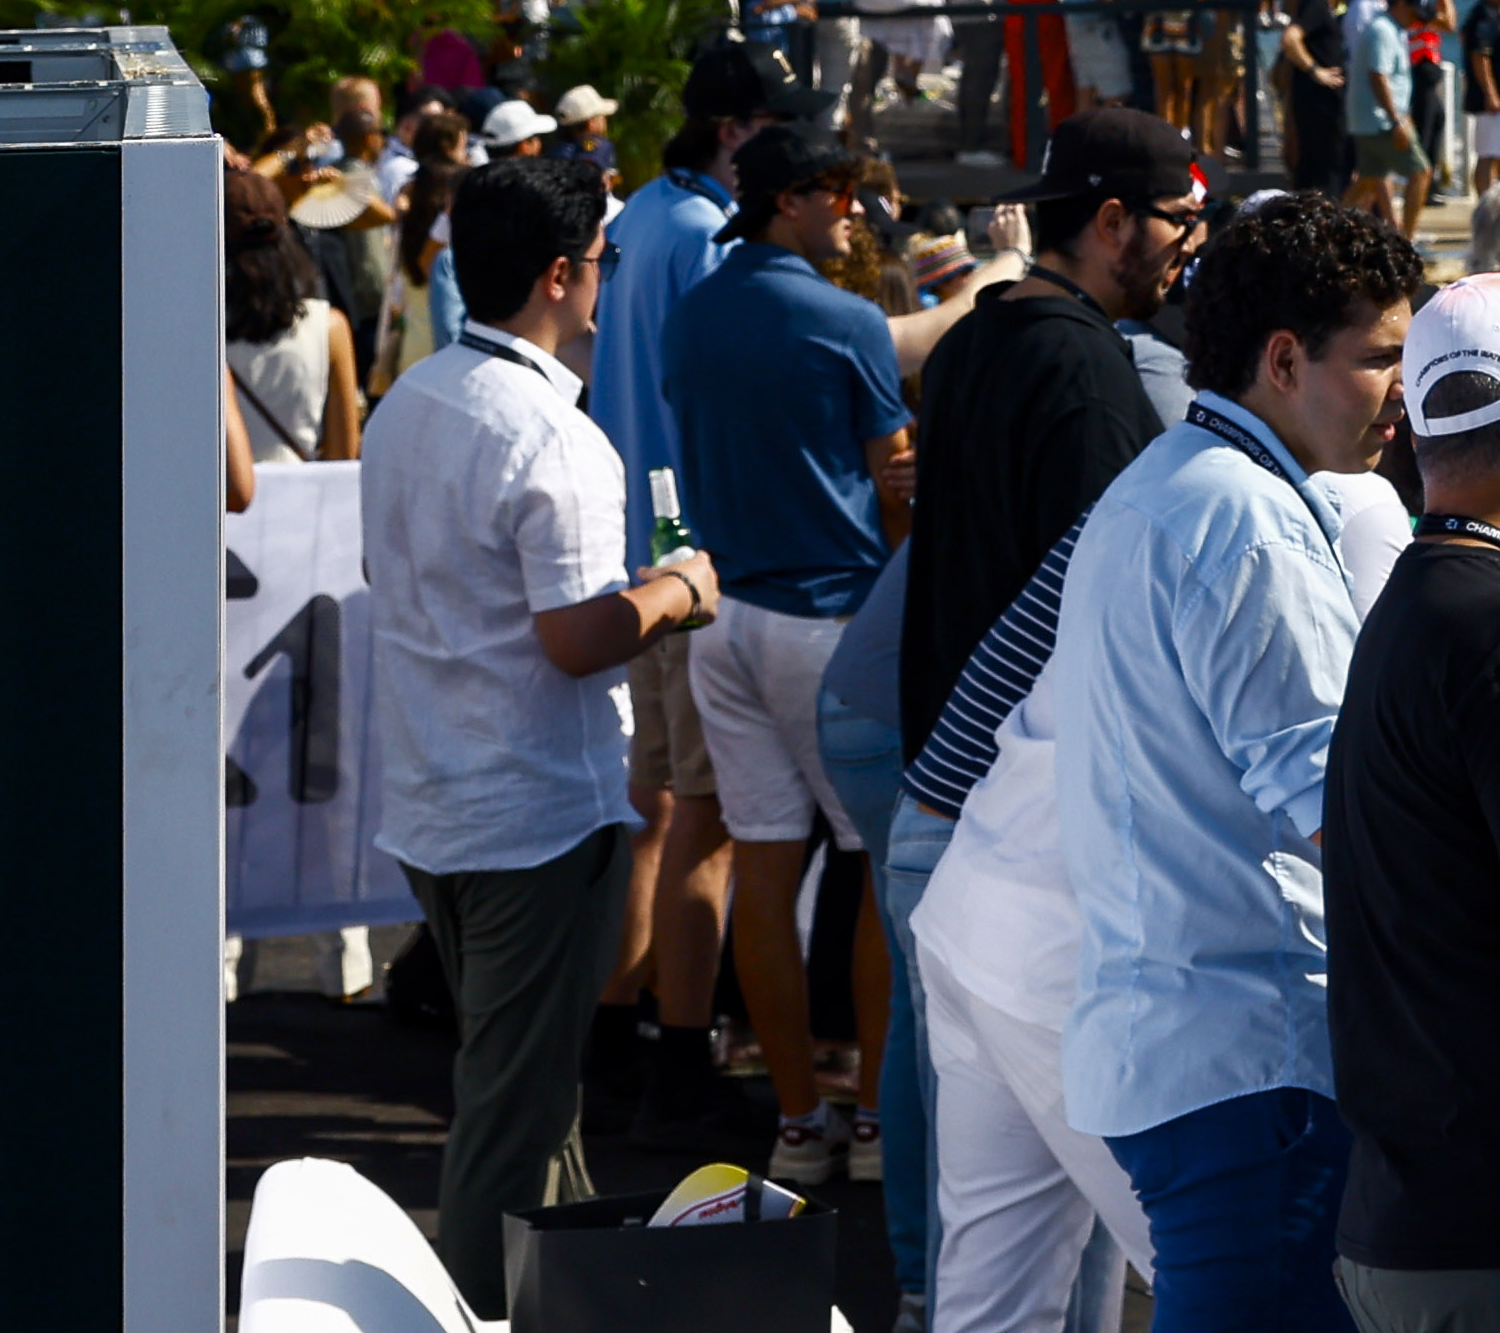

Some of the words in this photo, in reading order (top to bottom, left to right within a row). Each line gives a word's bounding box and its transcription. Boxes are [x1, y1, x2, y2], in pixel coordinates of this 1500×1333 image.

[1449, 350, 1462, 360] OF
[1462, 349, 1479, 358] THE
[1208, 417, 1261, 457] CHAMPIONS
[1259, 454, 1273, 469] OF
